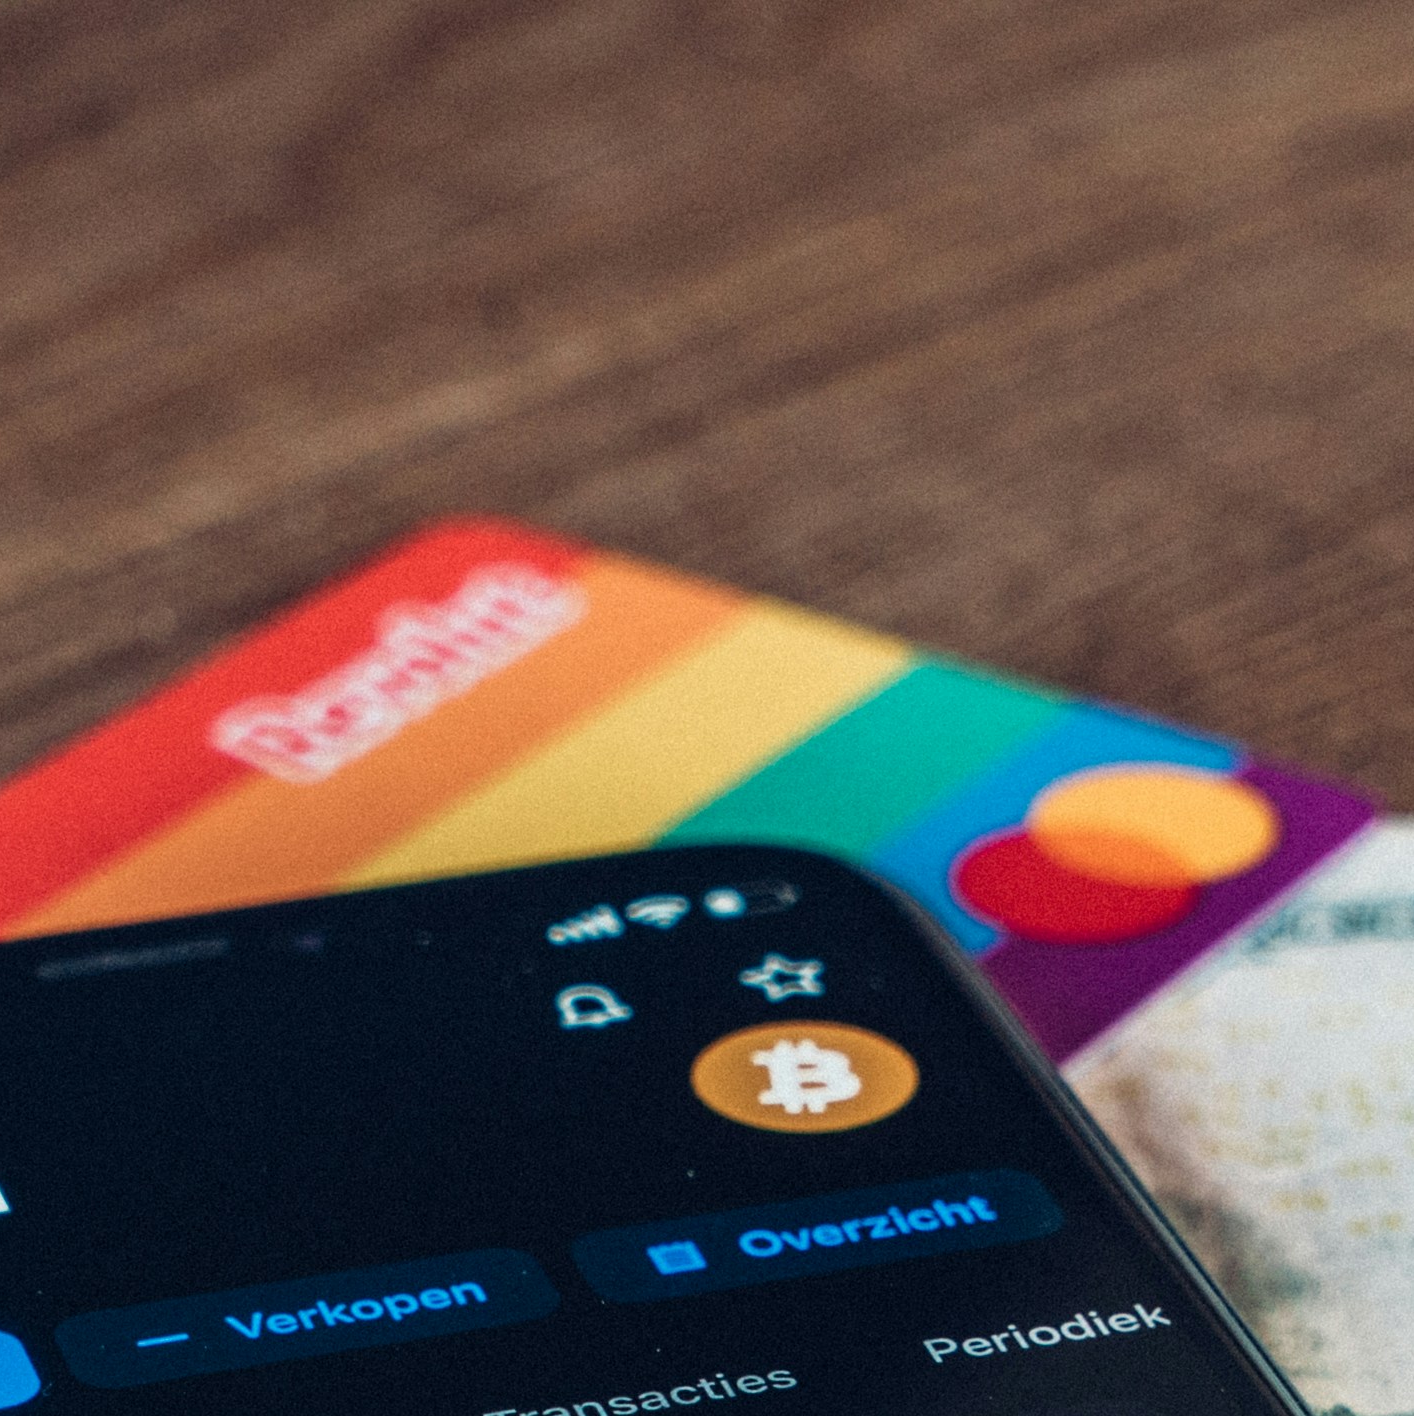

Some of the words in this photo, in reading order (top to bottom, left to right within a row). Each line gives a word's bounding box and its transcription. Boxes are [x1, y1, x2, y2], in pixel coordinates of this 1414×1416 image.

[737, 1195, 998, 1260] Overzicht
[225, 1277, 488, 1341] Verkopen
[923, 1302, 1172, 1365] Periodiek
